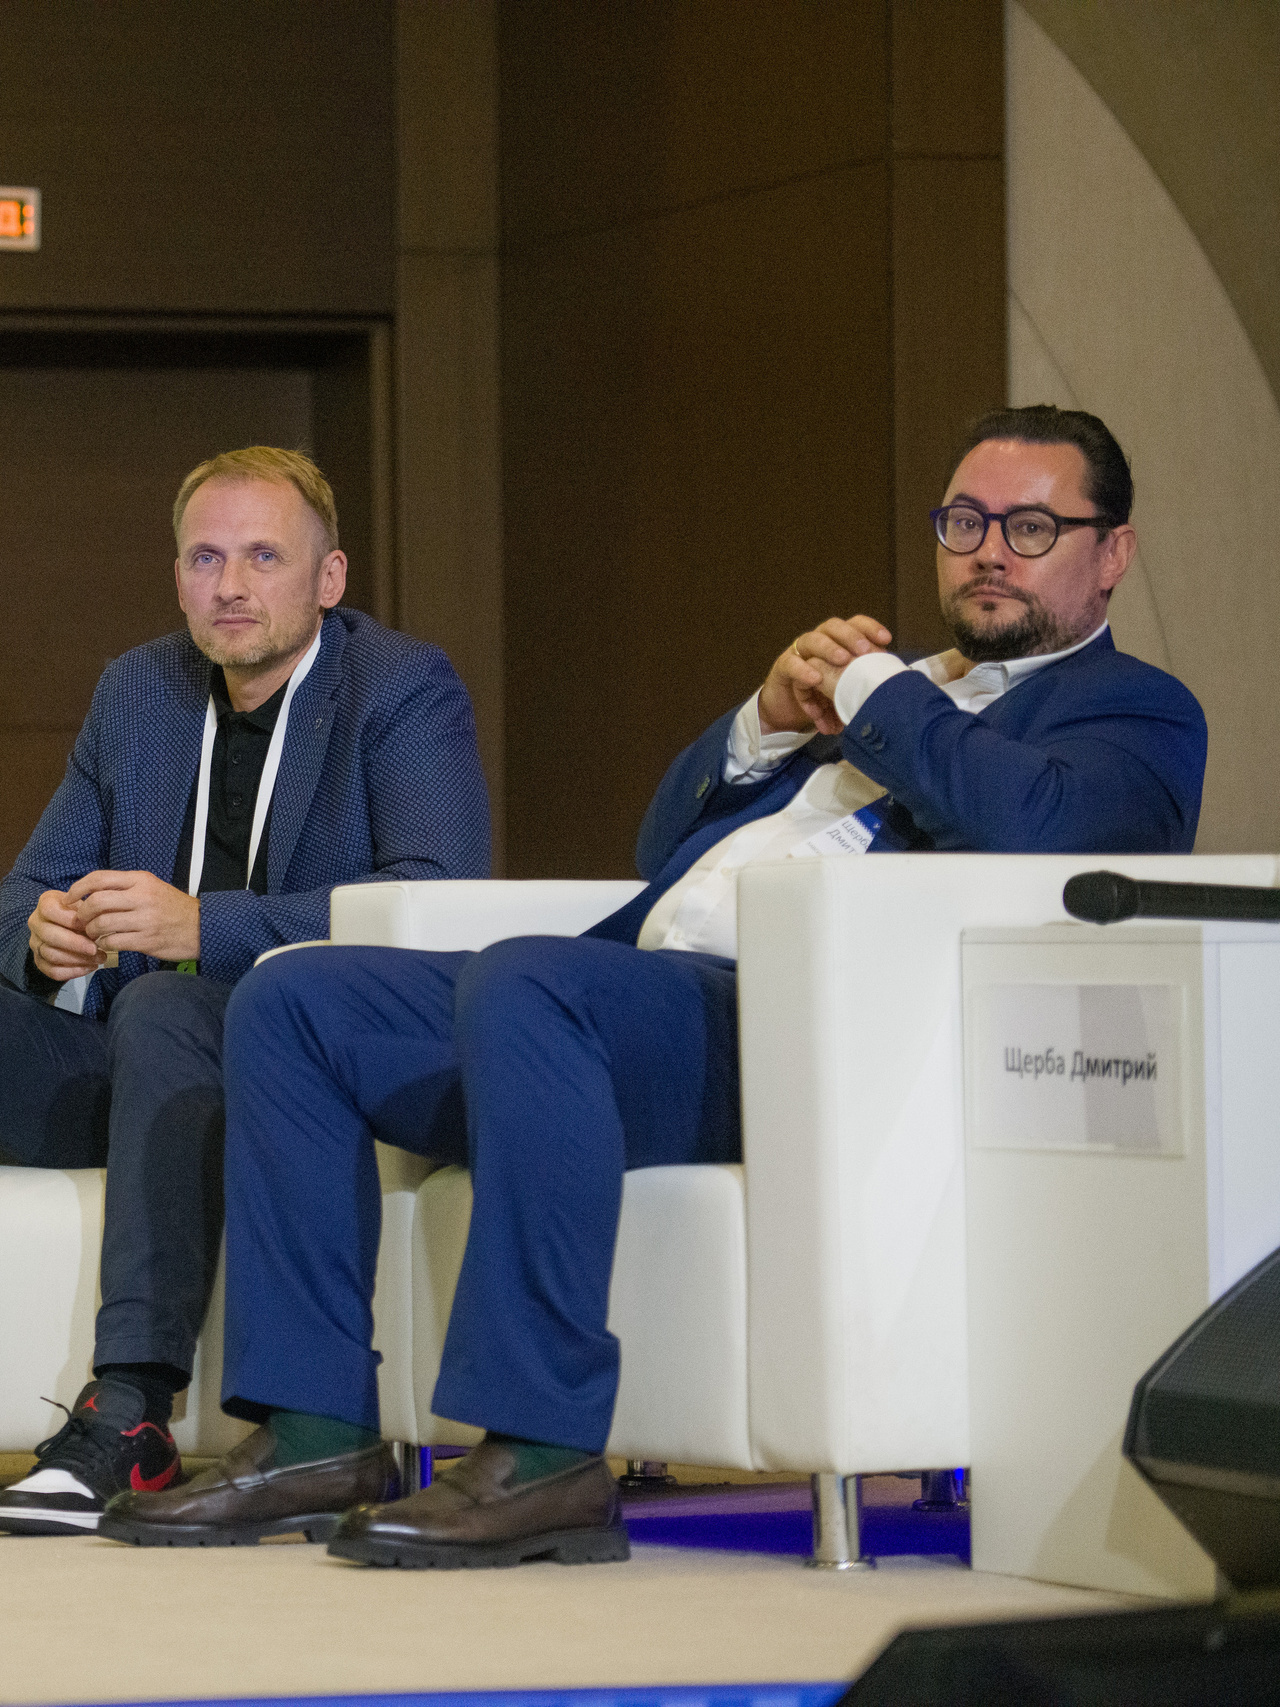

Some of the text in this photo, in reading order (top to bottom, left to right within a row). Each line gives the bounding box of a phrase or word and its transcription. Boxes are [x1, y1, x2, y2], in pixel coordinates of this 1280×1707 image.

[826, 829, 857, 854] Дмит
[1005, 1047, 1158, 1086] Щерба Дмитрий
